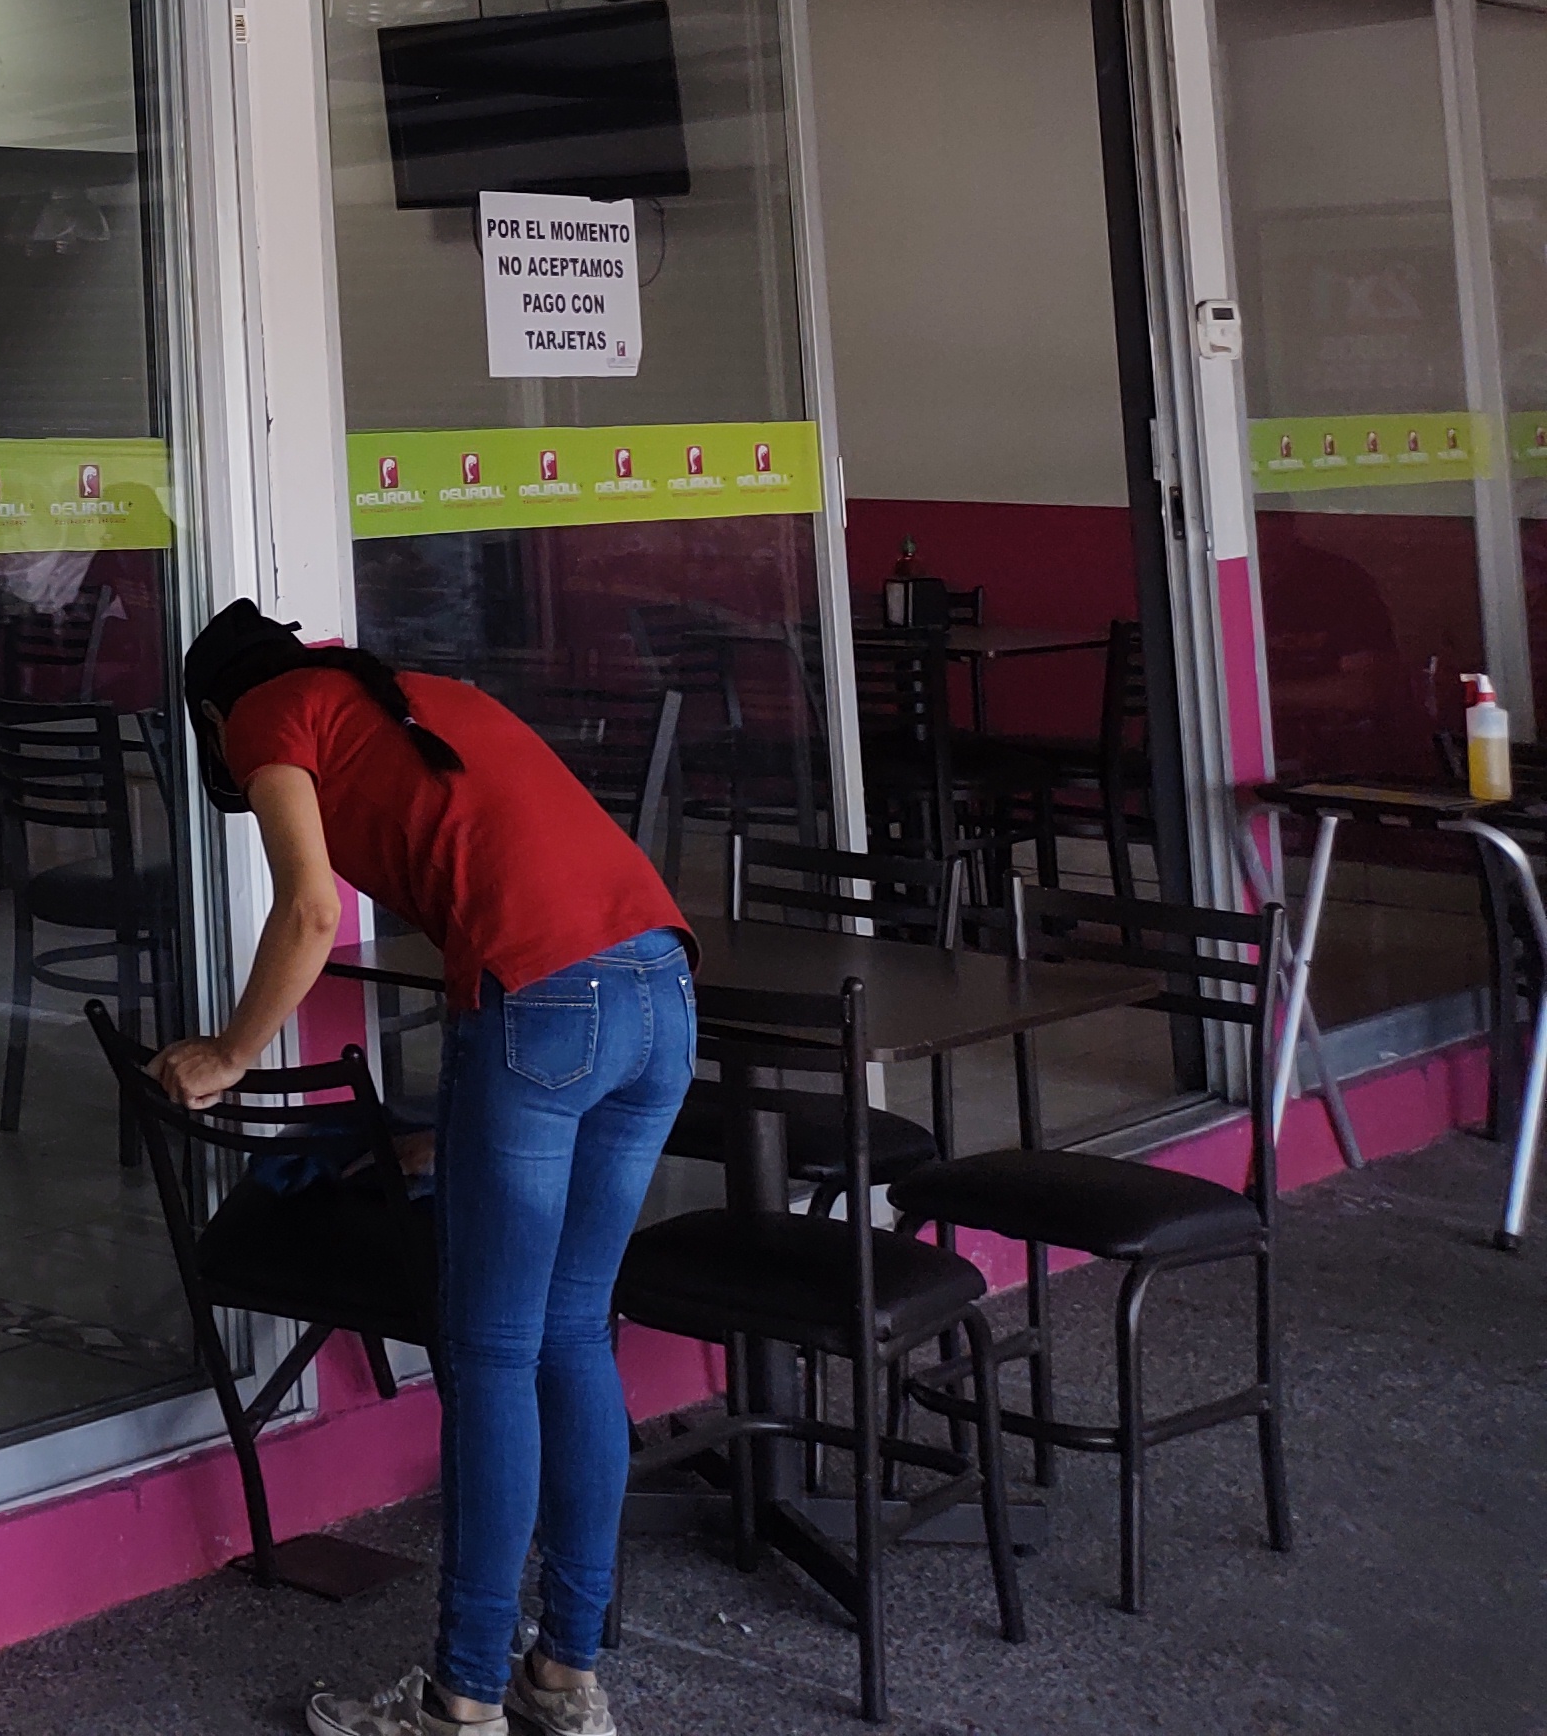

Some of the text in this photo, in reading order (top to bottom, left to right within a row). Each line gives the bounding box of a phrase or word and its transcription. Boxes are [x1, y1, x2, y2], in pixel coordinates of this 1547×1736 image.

[487, 218, 630, 243] POR EL MOMENTO
[498, 255, 624, 279] NO ACEPTAMOS
[522, 293, 605, 314] PAGO CON
[525, 330, 607, 350] TARJETAS
[356, 490, 424, 506] DELIROLL
[439, 485, 506, 502] DELIROLL
[50, 500, 129, 516] DELIROLL
